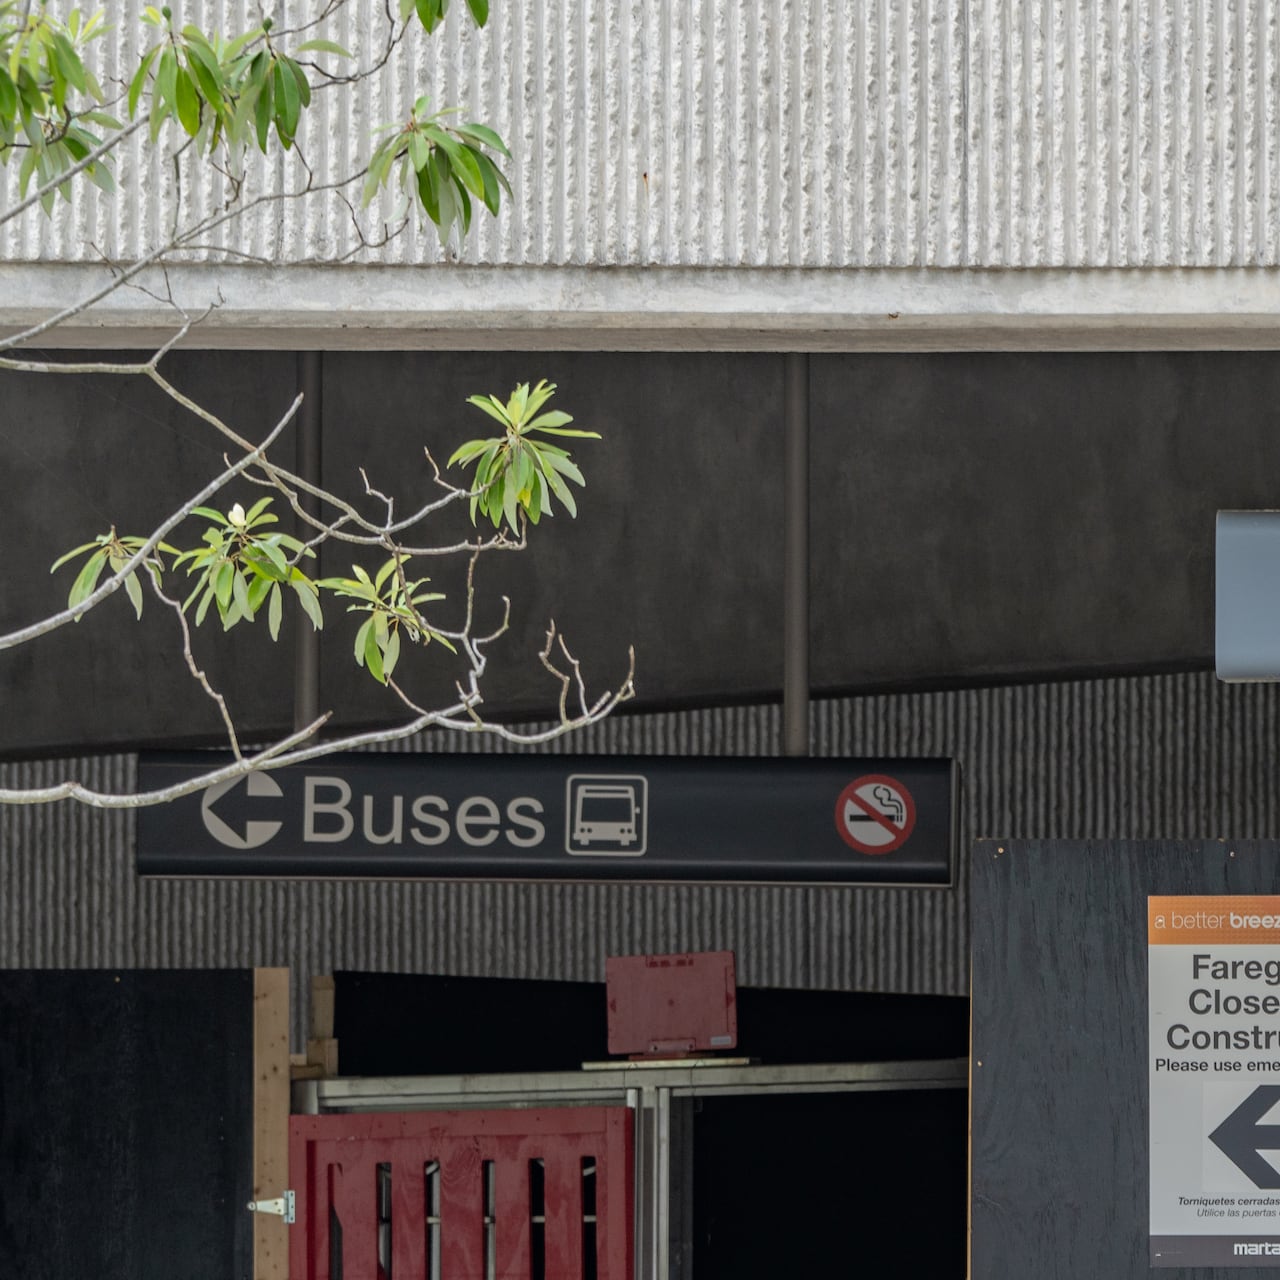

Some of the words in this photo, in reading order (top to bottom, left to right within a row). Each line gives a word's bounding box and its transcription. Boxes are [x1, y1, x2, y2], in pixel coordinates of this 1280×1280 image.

[303, 775, 546, 848] Buses
[1154, 914, 1166, 929] a
[1171, 911, 1226, 929] better
[1155, 1058, 1209, 1072] Please
[1213, 1061, 1242, 1072] use
[1178, 1197, 1235, 1207] Torniquetes
